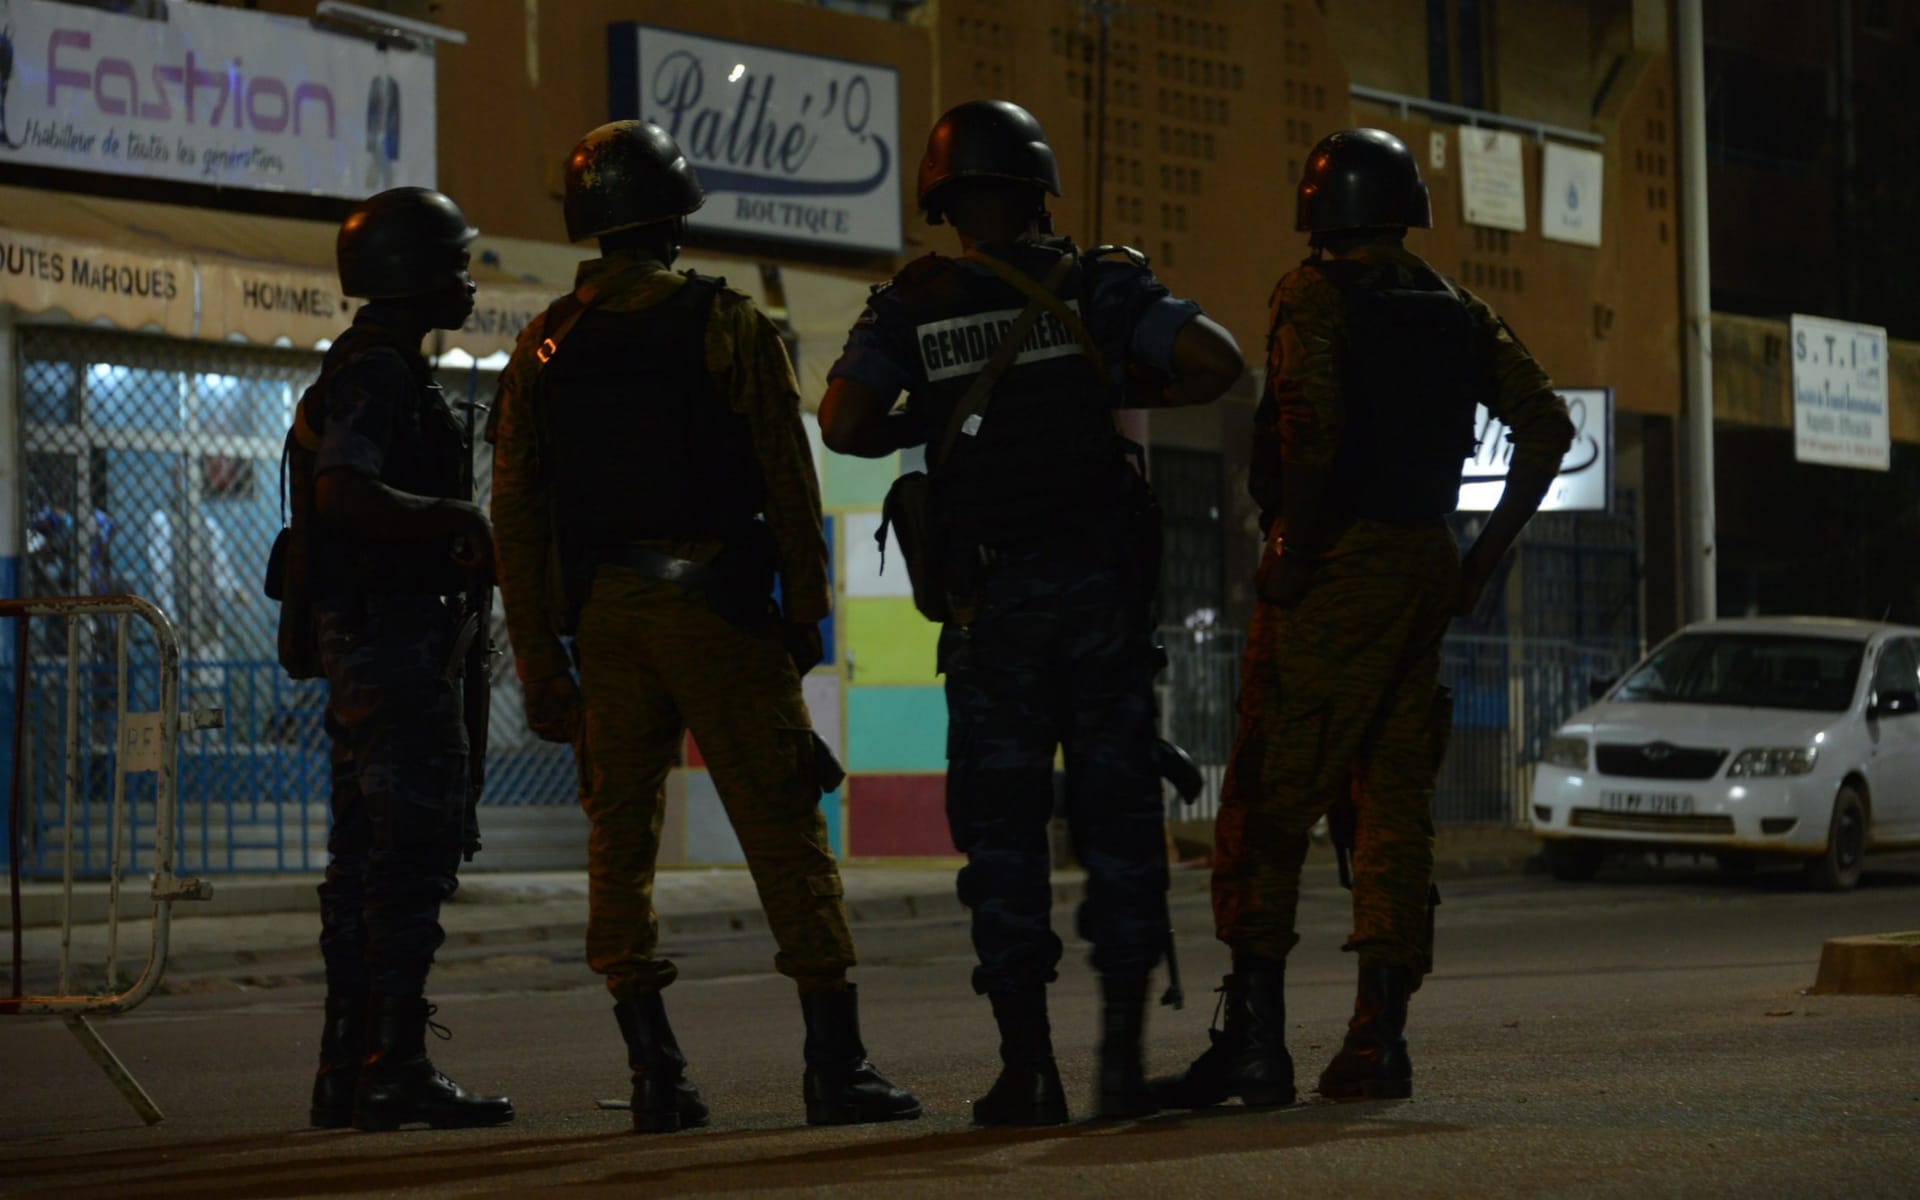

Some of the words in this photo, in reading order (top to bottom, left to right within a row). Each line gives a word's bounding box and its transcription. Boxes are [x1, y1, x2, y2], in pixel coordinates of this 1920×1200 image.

[102, 128, 119, 152] de
[735, 196, 850, 234] BOUTIQUE
[71, 256, 177, 300] MARQUES
[243, 280, 334, 318] HOMMES
